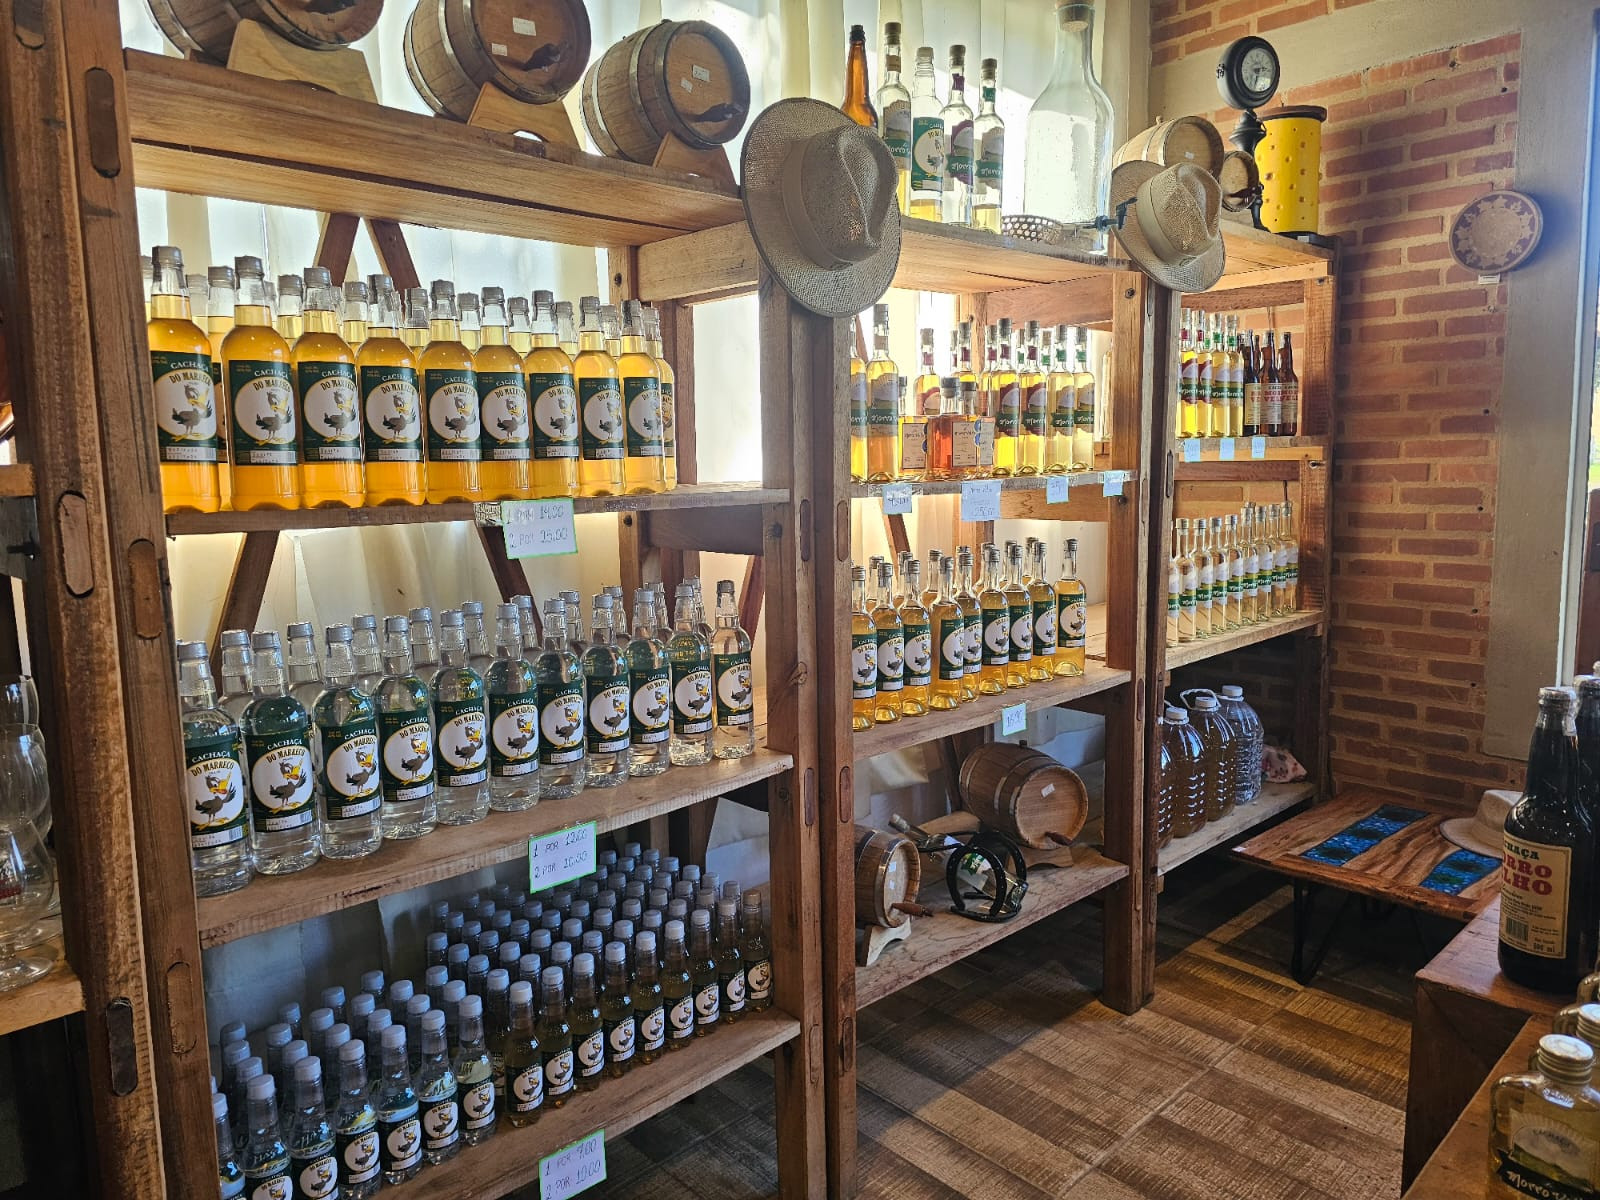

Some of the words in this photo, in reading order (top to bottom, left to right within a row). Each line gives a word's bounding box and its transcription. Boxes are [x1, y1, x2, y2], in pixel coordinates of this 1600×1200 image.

[169, 373, 181, 384] DO
[253, 382, 264, 391] DO
[320, 381, 331, 391] DO
[381, 386, 391, 394] DO
[506, 710, 515, 718] DO
[454, 719, 462, 727] DO
[344, 728, 375, 740] CACHAÇA
[400, 730, 409, 738] DO
[267, 738, 303, 750] CACHAÇA
[343, 744, 353, 753] DO
[192, 750, 231, 763] CACHAÇA
[266, 755, 276, 763] DO
[277, 748, 305, 758] MARRECO
[190, 766, 202, 777] DO
[203, 760, 234, 772] MARRECO
[533, 843, 538, 858] 1
[1503, 850, 1552, 879] RRO
[534, 866, 540, 879] 2
[544, 1160, 550, 1177] 1
